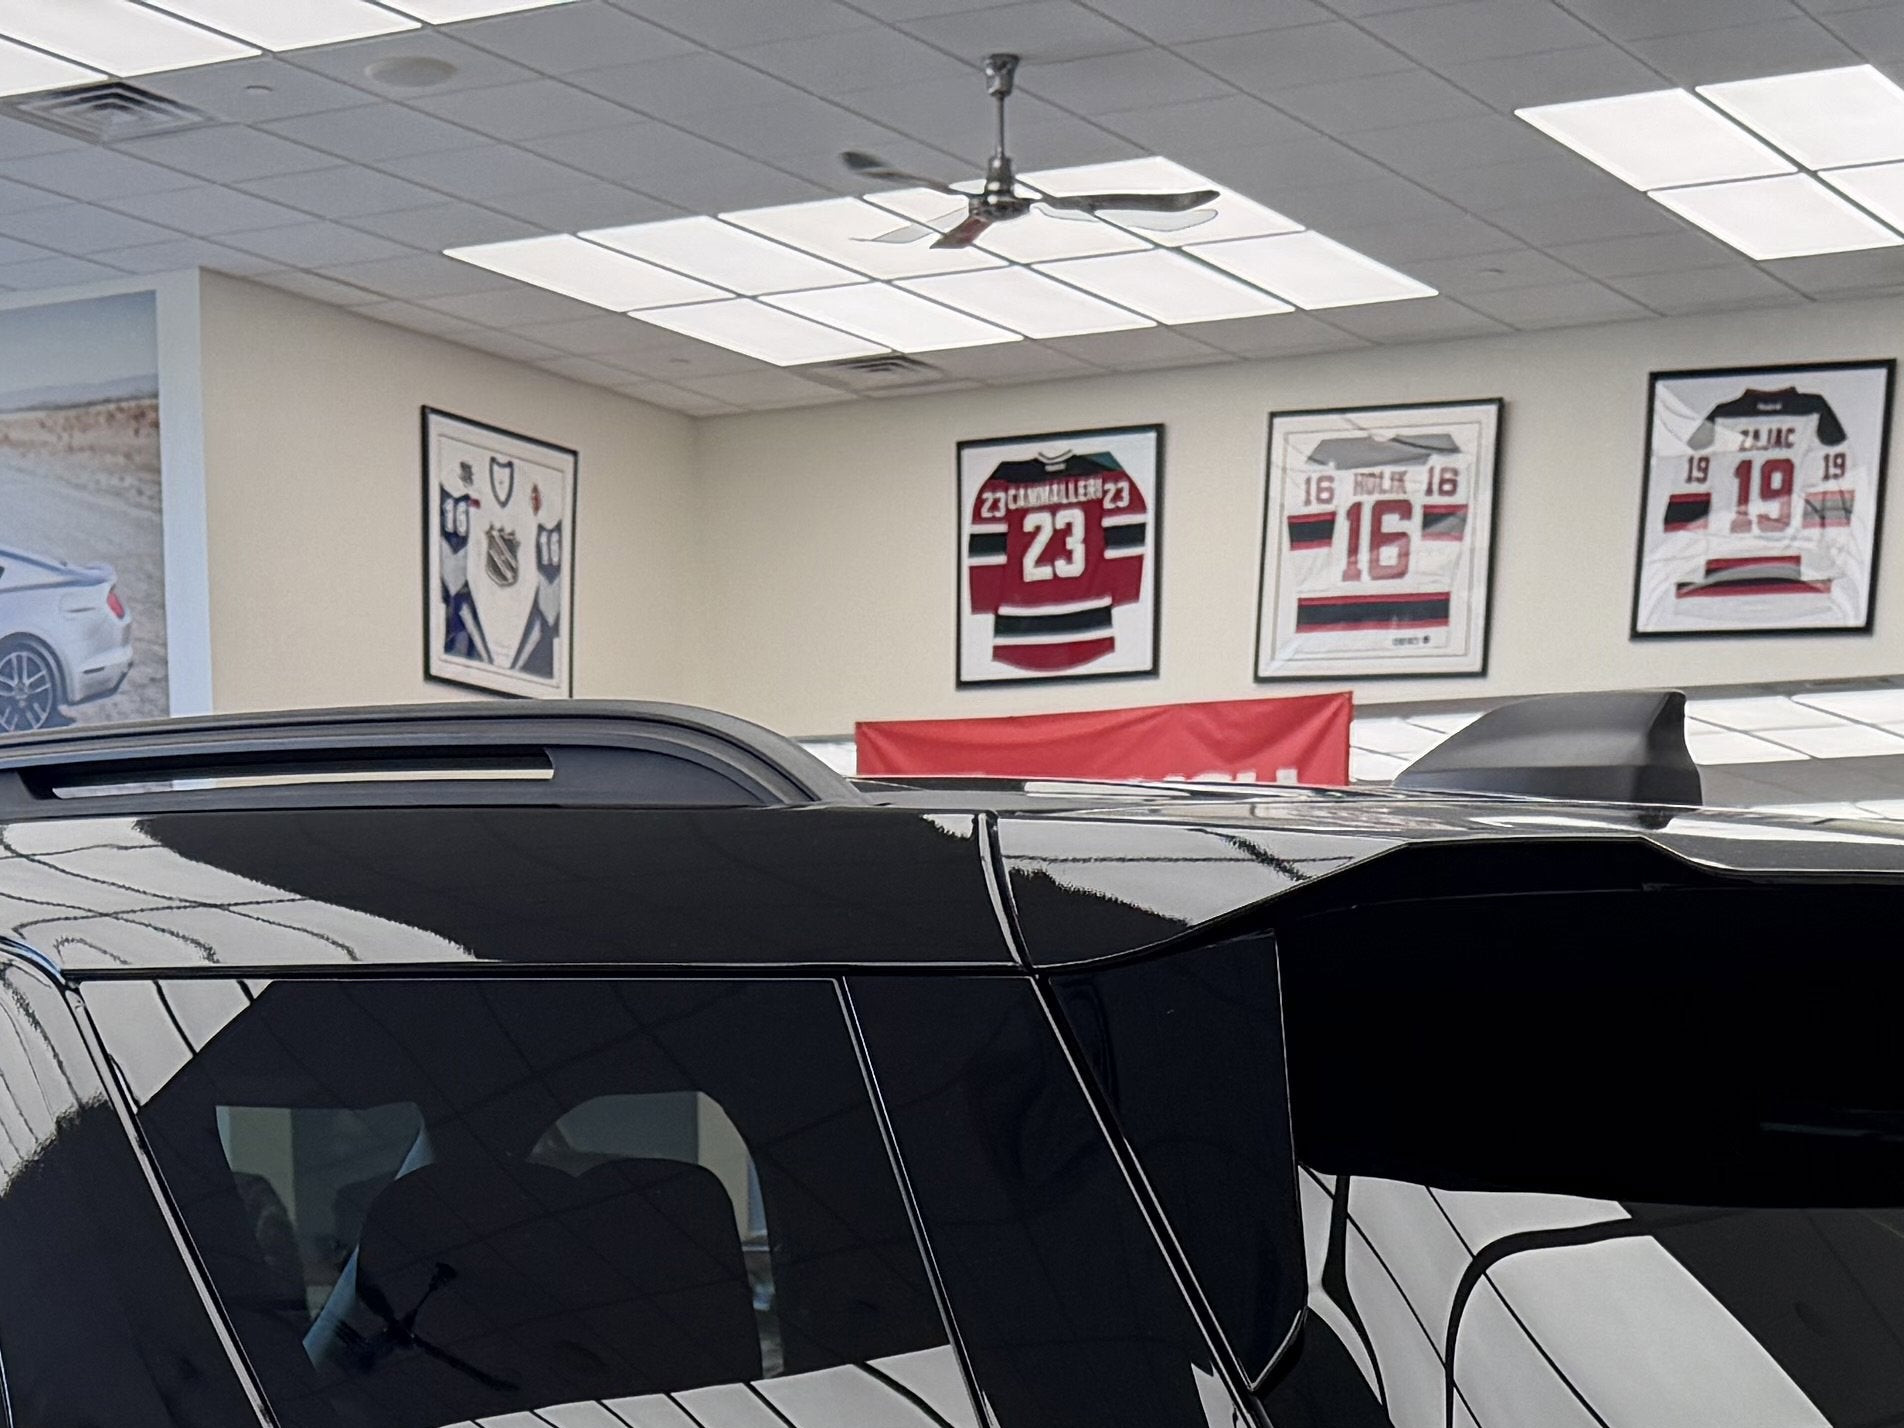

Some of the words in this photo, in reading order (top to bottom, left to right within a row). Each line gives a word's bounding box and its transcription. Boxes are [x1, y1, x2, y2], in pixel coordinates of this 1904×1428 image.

[1424, 465, 1459, 497] 16
[1685, 455, 1711, 484] 19
[1822, 452, 1847, 481] 19
[1102, 481, 1130, 510] 23
[1303, 474, 1335, 507] 16
[1352, 470, 1409, 497] HOLIK
[1729, 458, 1795, 534] 19
[980, 491, 1007, 519] 23
[1022, 508, 1087, 583] 23
[1342, 499, 1414, 582] 16
